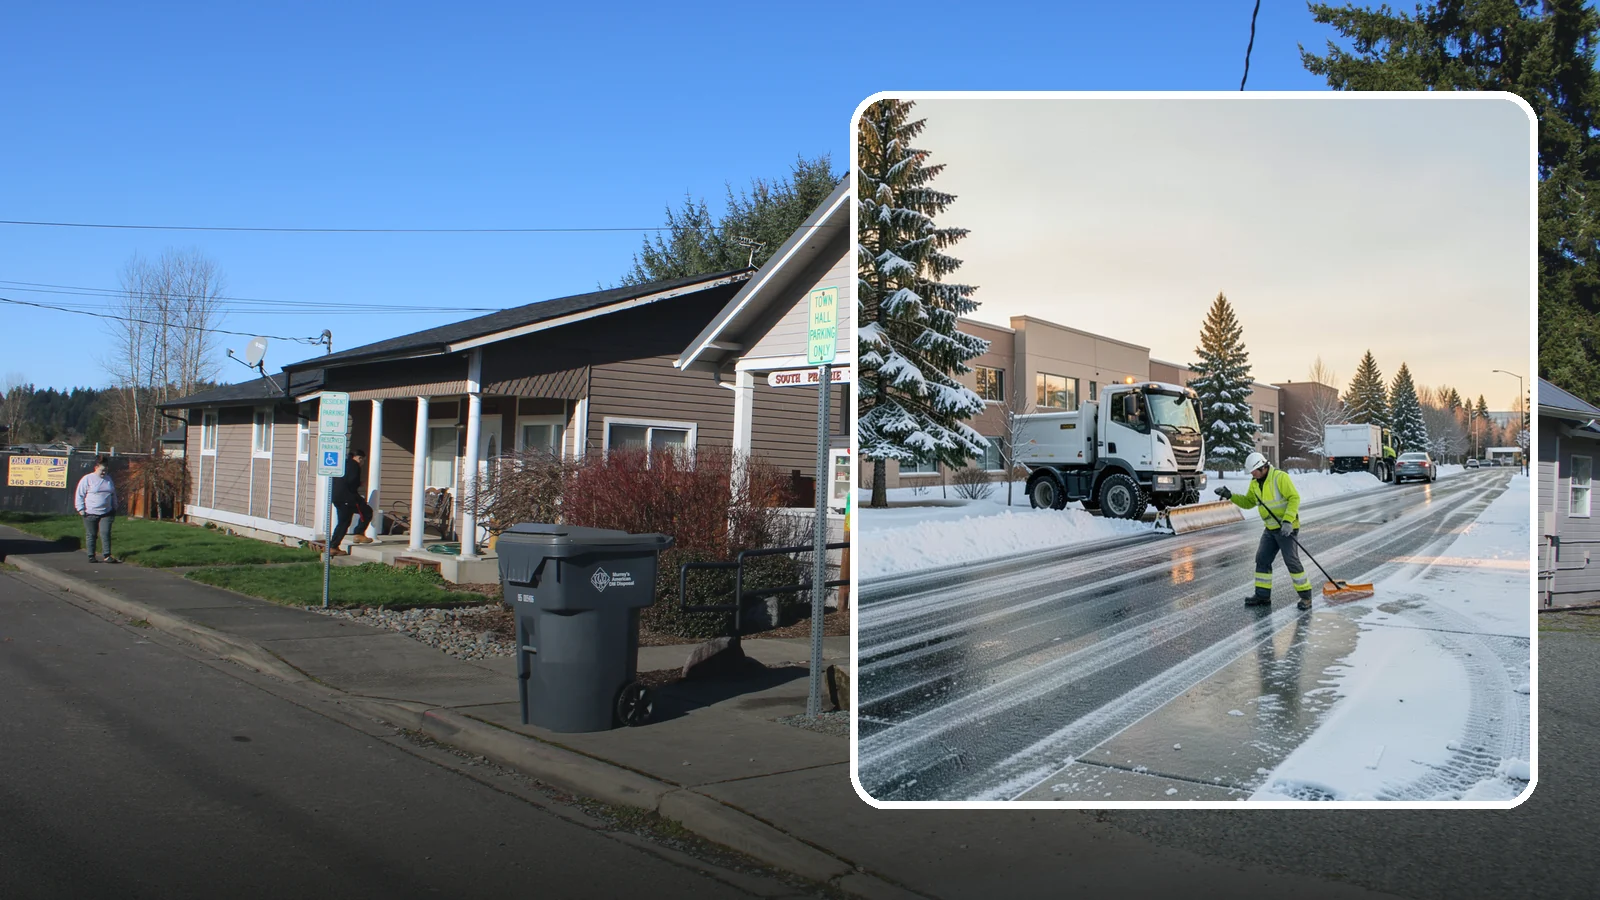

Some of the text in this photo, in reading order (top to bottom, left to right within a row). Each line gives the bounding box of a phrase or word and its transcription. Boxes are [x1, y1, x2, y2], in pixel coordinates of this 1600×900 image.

[815, 295, 833, 308] TOWN
[814, 312, 831, 325] HALL
[810, 326, 836, 341] PARKING
[813, 344, 831, 357] ONLY
[775, 373, 801, 384] SOUTH
[323, 409, 345, 417] PARKING
[325, 420, 340, 428] ONLY
